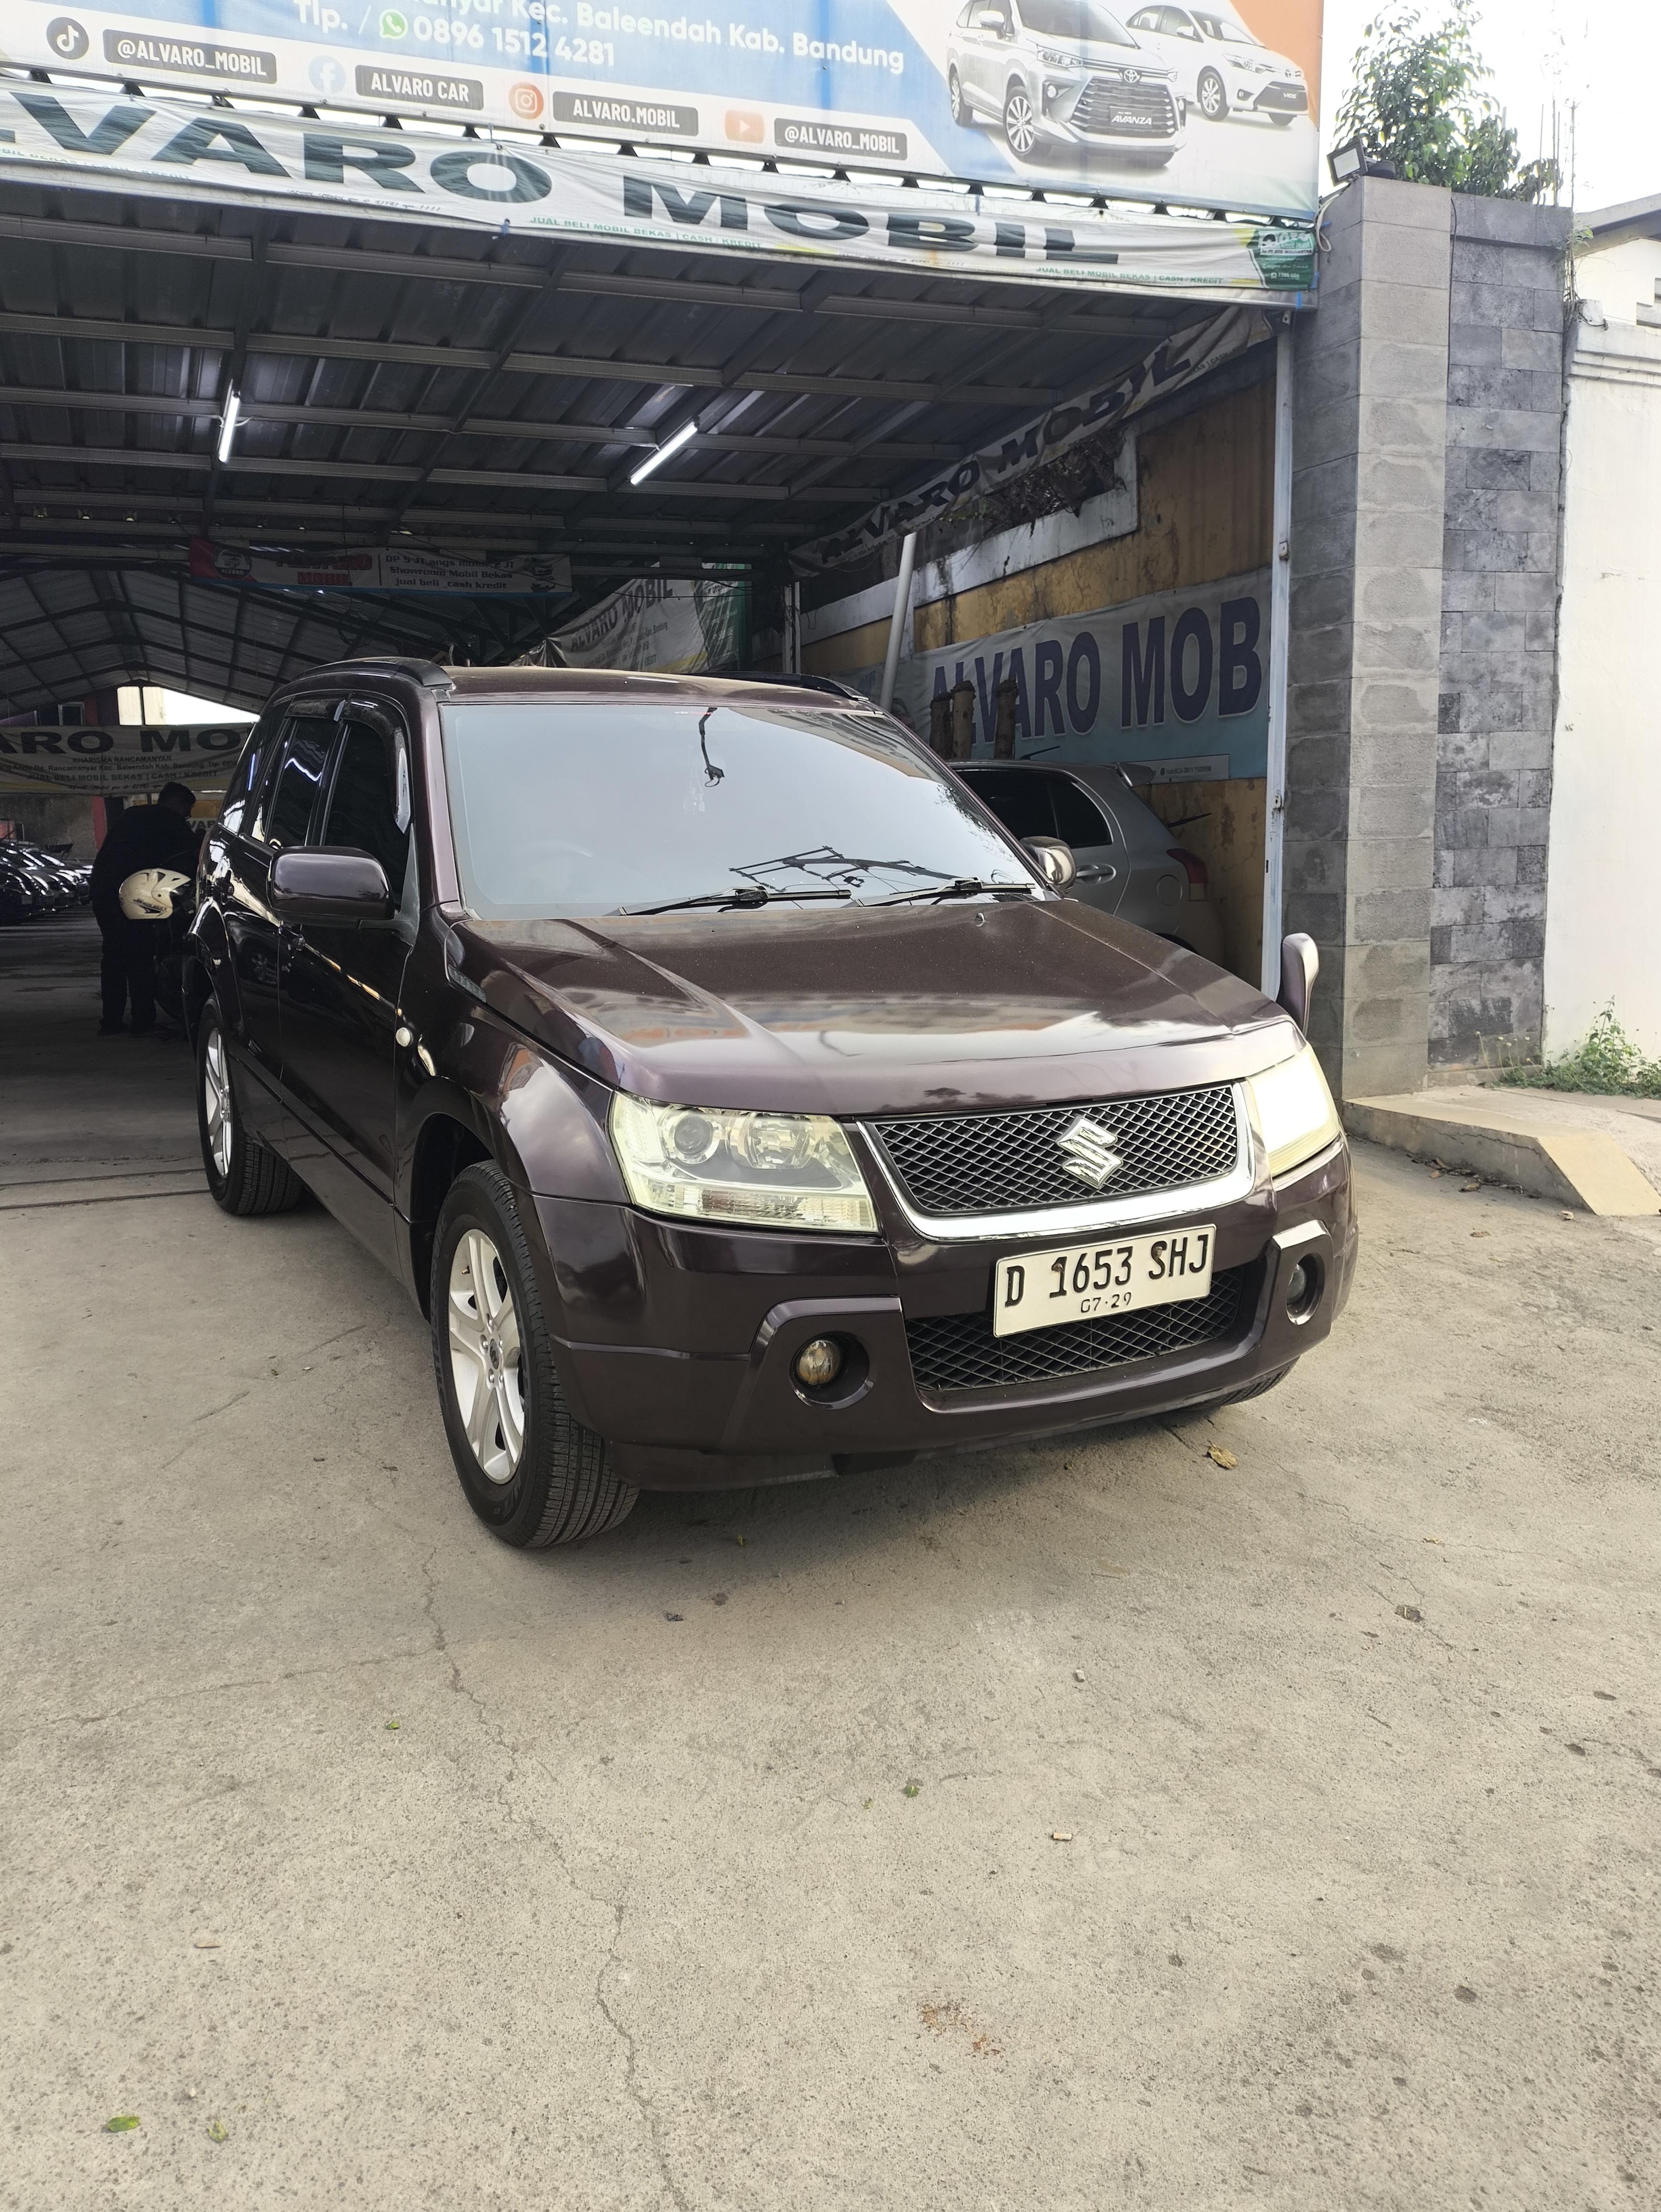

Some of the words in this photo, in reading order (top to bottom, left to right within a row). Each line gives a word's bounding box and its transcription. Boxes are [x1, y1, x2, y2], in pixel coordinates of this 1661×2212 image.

[297, 1, 348, 33] Tlp.
[413, 16, 484, 48] 0896
[491, 27, 547, 57] 1512
[554, 36, 615, 66] 4281
[511, 0, 568, 24] Kec.
[577, 2, 720, 44] Baleendah
[730, 23, 785, 54] Kab.
[793, 33, 904, 74] Bandung
[117, 39, 266, 76] @ALVARO_MOBIL
[371, 72, 433, 97] ALVARO
[437, 81, 469, 102] CAR
[573, 99, 680, 128] ALVARO.MOBIL
[1111, 115, 1152, 125] AVANZA
[785, 126, 900, 154] @ALVARO_MOBIL
[0, 91, 553, 204] VARO
[623, 175, 1118, 264] MOBIL
[530, 216, 561, 226] JUAL
[564, 220, 589, 229] BELI
[593, 223, 630, 234] MOBIL
[634, 227, 671, 238] BEKAS
[682, 233, 712, 243] CASH
[721, 238, 762, 249] KREDIT
[1036, 266, 1061, 275] JUAL
[1087, 270, 1117, 278] MOBIL
[1119, 272, 1150, 281] BEKAS
[1190, 276, 1224, 285] KREDIT
[386, 555, 399, 563] DP
[414, 556, 425, 564] JT
[390, 566, 445, 577] Showroom
[449, 570, 477, 578] Mobil
[395, 578, 416, 586] jual
[476, 581, 507, 589] kredit
[139, 727, 252, 752] MO
[1005, 1265, 1025, 1307] D
[1049, 1246, 1134, 1299] 1653
[1148, 1234, 1210, 1280] SHJ
